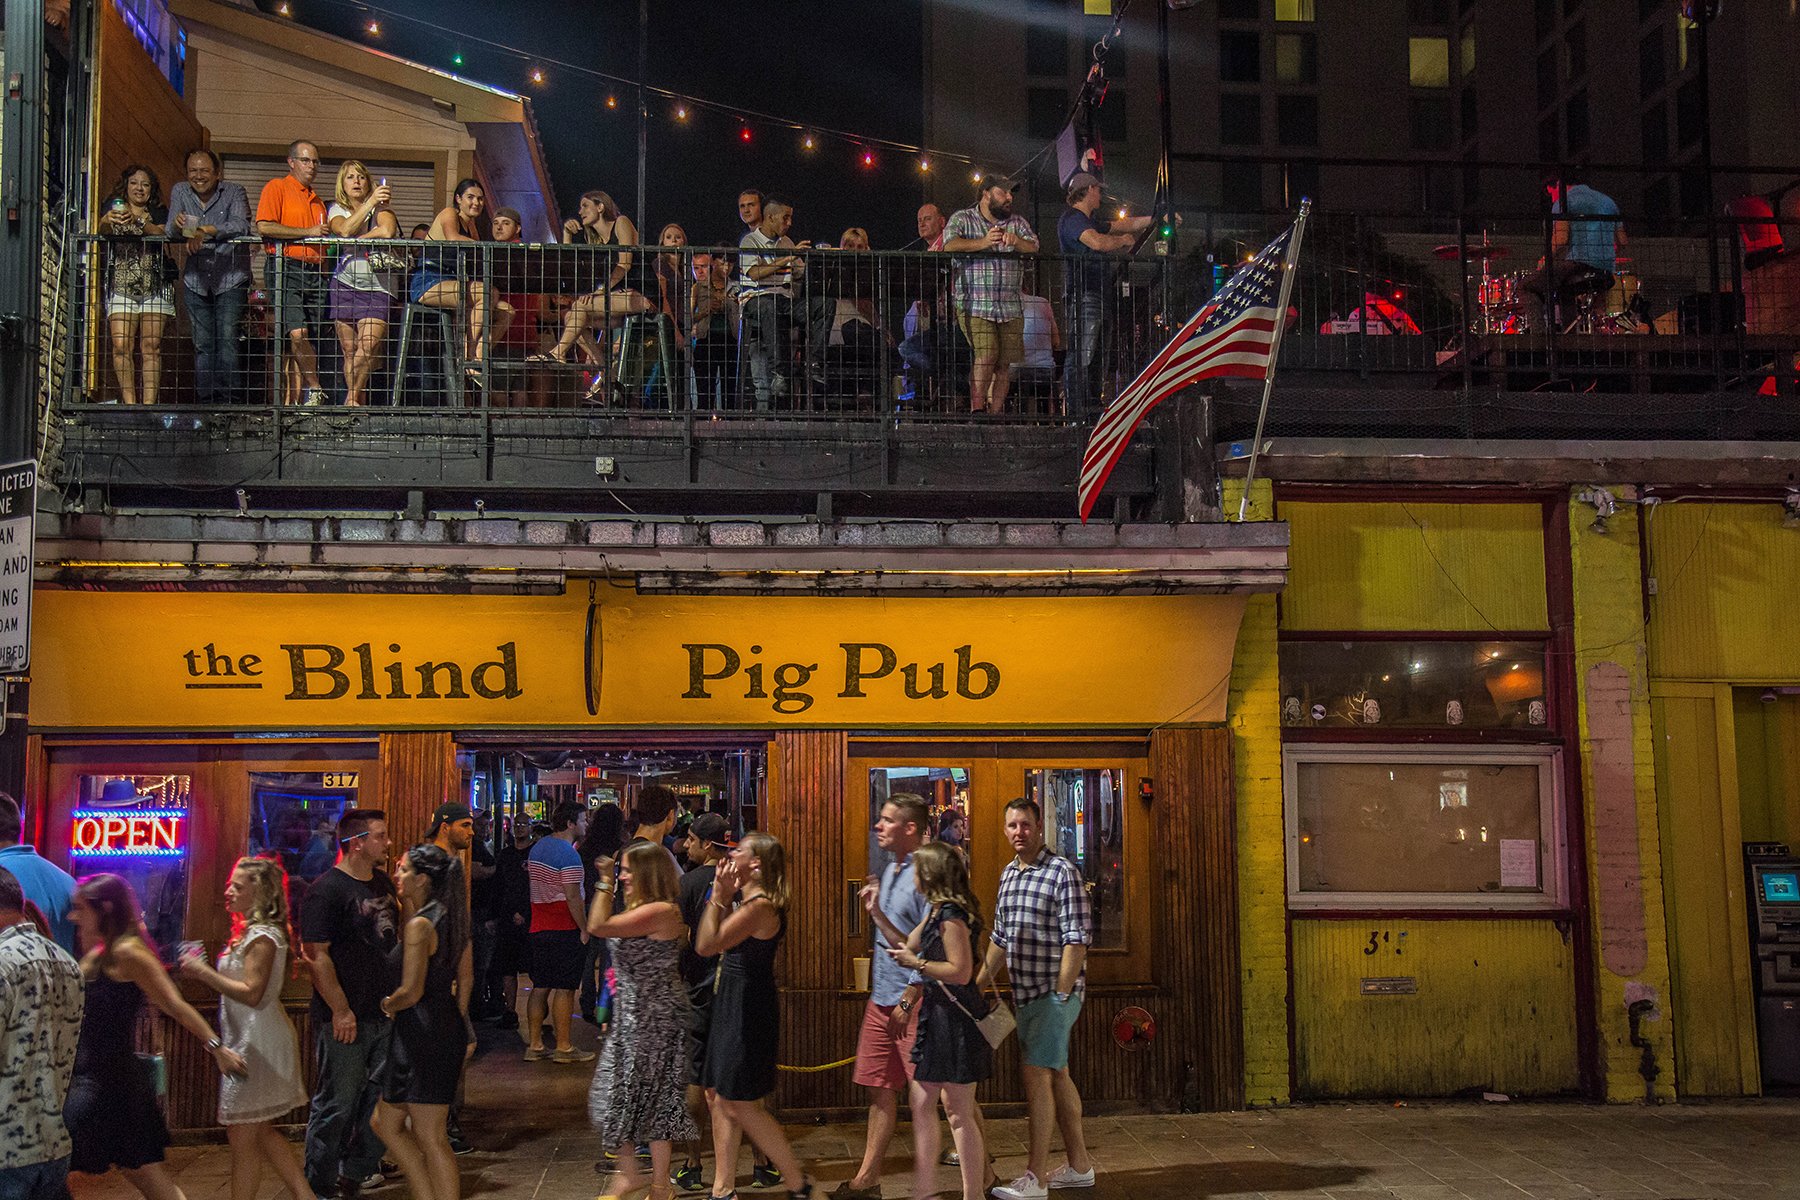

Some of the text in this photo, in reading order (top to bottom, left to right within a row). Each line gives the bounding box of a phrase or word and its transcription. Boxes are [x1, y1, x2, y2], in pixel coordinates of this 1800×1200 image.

[3, 555, 28, 576] AND
[183, 642, 1001, 714] the Blind Pig Pub
[325, 772, 358, 787] 317
[77, 816, 179, 850] OPEN
